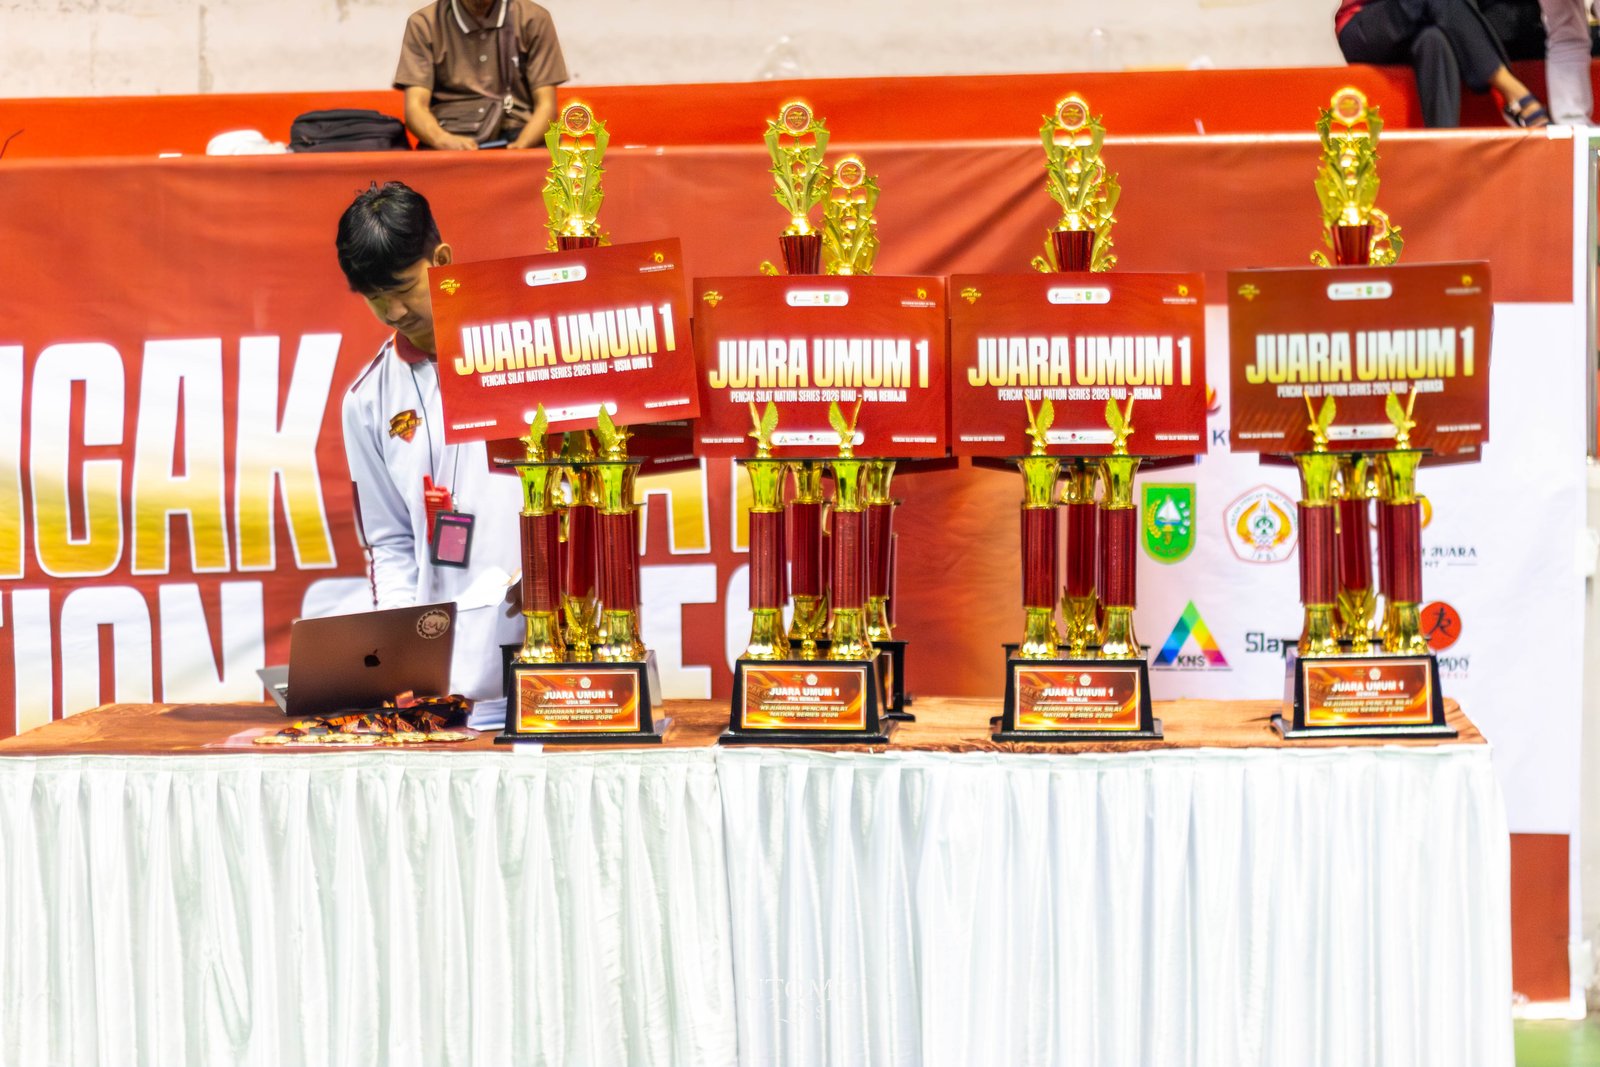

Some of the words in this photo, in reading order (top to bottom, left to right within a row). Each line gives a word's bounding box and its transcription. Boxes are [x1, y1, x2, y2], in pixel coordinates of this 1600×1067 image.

[454, 318, 557, 376] JUARA
[558, 306, 658, 363] UMUM
[659, 303, 676, 351] 1
[709, 339, 808, 389] JUARA
[813, 338, 911, 388] UMUM
[915, 339, 929, 389] 1
[967, 337, 1071, 387] JUARA
[1075, 336, 1173, 386] UMUM
[1177, 336, 1192, 386] 1
[1246, 332, 1352, 384] JUARA
[1356, 327, 1456, 381] UMUM
[1460, 326, 1475, 377] 1
[482, 372, 506, 387] PENCAK
[508, 370, 524, 384] SILAT
[550, 365, 572, 379] SERIES
[574, 363, 591, 376] 2026
[731, 390, 754, 402] PENCAK
[798, 389, 820, 402] SERIES
[822, 389, 839, 401] 2026
[998, 388, 1023, 400] PENCAK
[1068, 387, 1090, 400] SERIES
[1092, 387, 1110, 400] 2026
[0, 334, 342, 579] CAK
[0, 581, 266, 736] ION
[1177, 656, 1206, 667] KNS
[544, 691, 574, 699] JUARA
[576, 690, 606, 699] UMUM
[608, 690, 613, 698] 1
[770, 688, 800, 696] JUARA
[802, 688, 832, 696] UMUM
[834, 688, 840, 696] 1
[1042, 688, 1074, 696] JUARA
[1076, 688, 1106, 696] UMUM
[1108, 688, 1114, 696] 1
